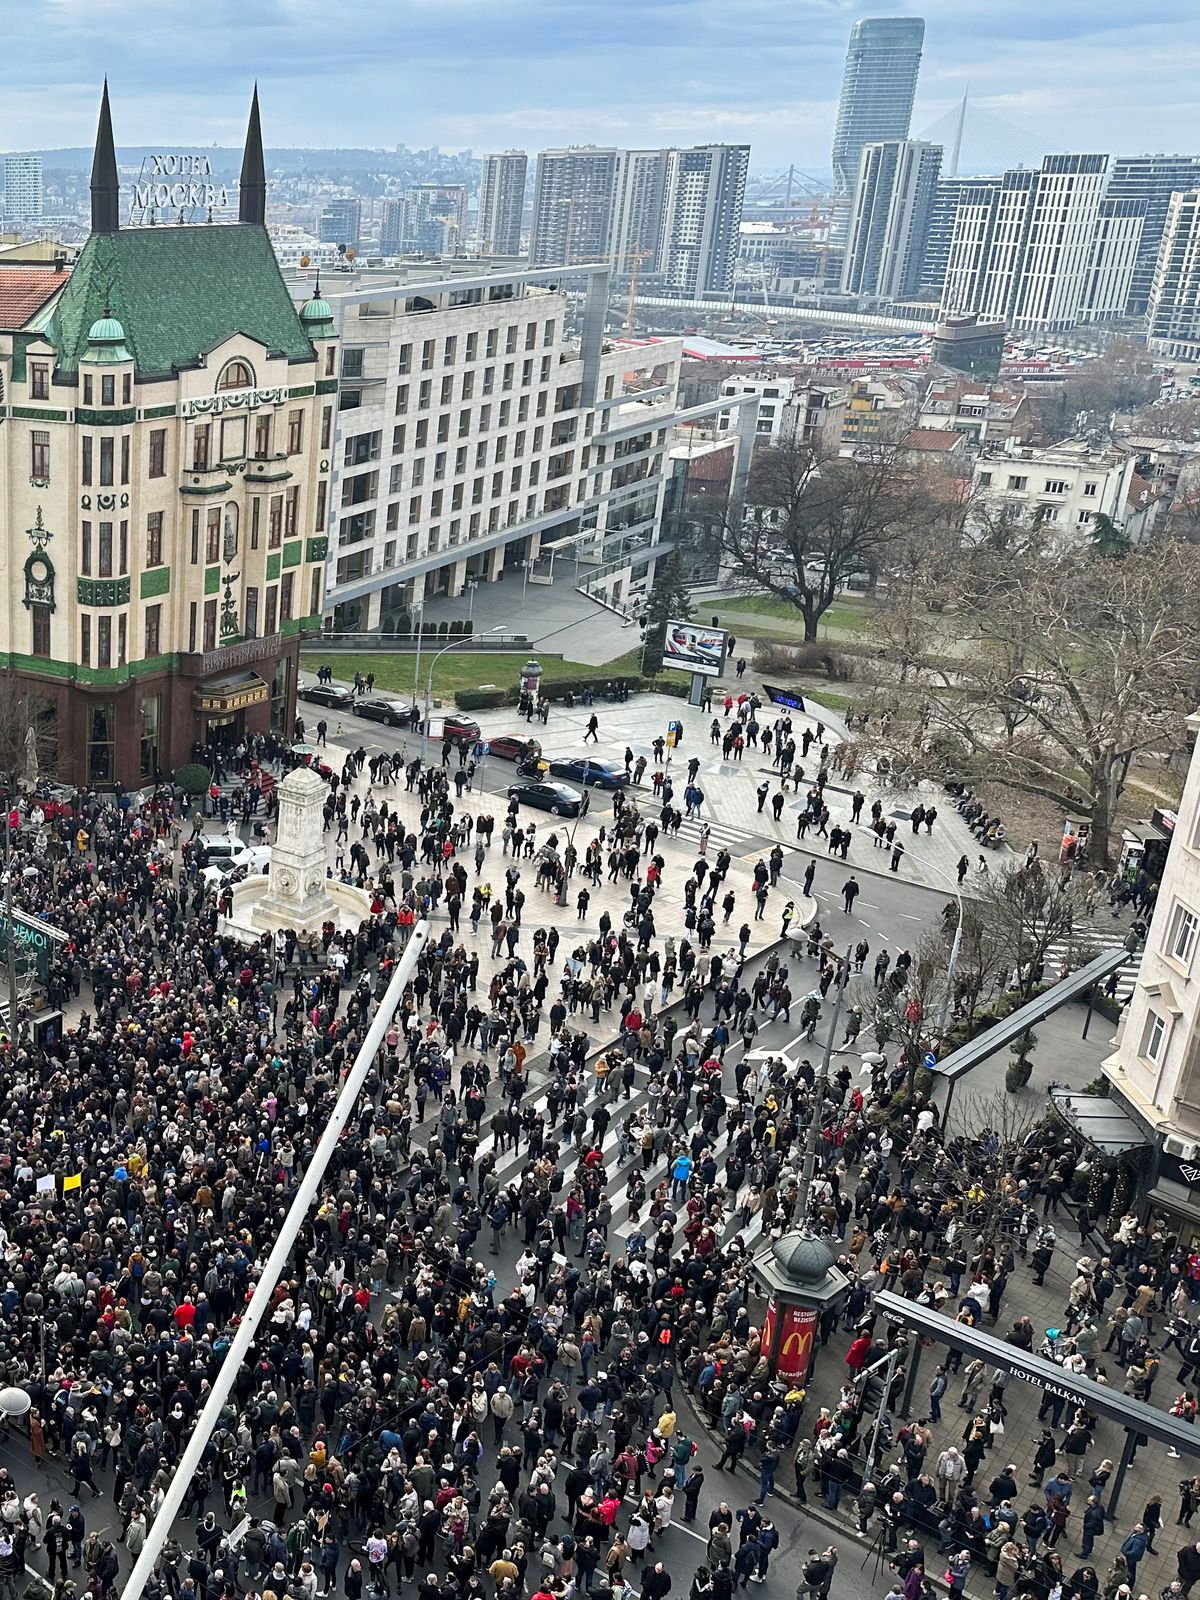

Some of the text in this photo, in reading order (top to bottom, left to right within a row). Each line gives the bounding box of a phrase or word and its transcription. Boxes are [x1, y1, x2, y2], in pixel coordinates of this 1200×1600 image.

[151, 154, 213, 176] ХОТЕЛ
[132, 183, 229, 208] МОСКВА
[1009, 1366, 1087, 1407] HOTEL BALKAN
